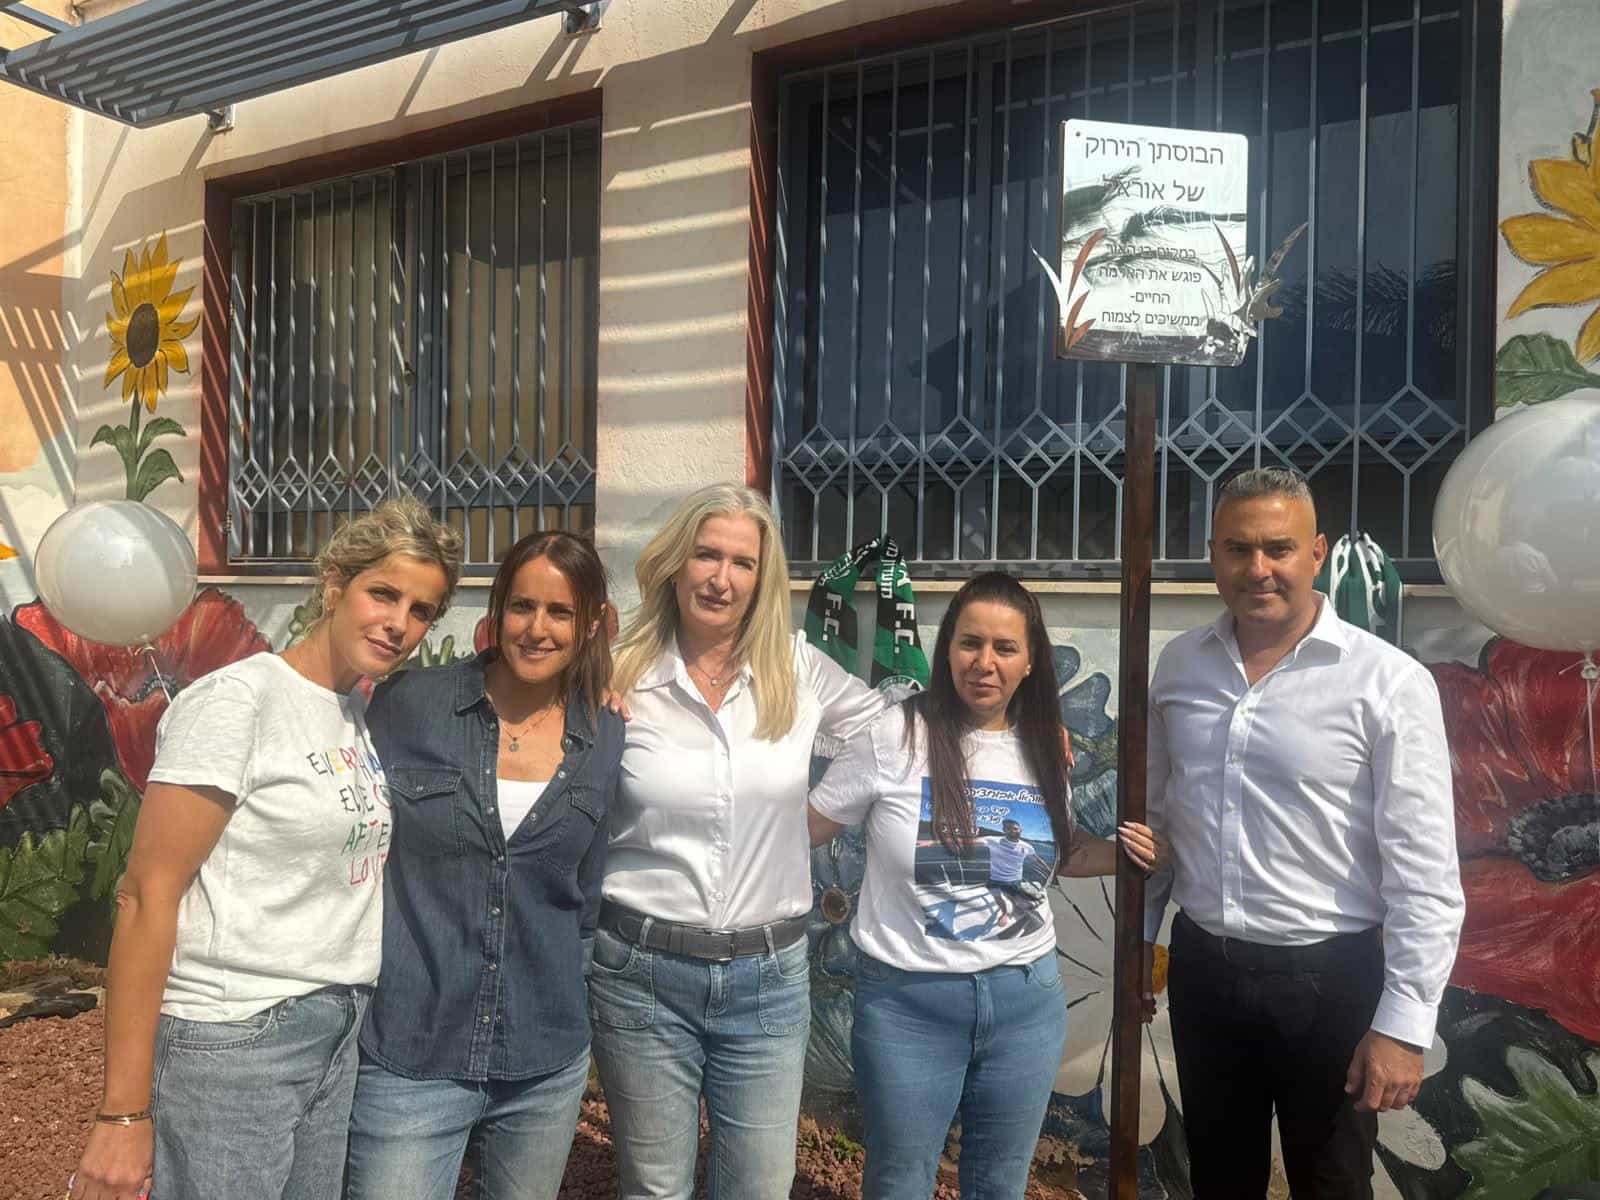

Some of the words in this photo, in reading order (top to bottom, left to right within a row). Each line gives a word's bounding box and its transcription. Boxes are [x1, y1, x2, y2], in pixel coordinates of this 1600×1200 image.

[1086, 137, 1141, 159] הירוק
[1148, 142, 1224, 165] הבוסתן
[1173, 179, 1205, 202] של
[1149, 269, 1168, 281] את
[1171, 270, 1202, 283] פוגש
[1102, 309, 1141, 323] לצמוח
[1145, 313, 1201, 327] ממשיכים
[822, 592, 843, 641] F.C.
[894, 602, 915, 654] F.C.
